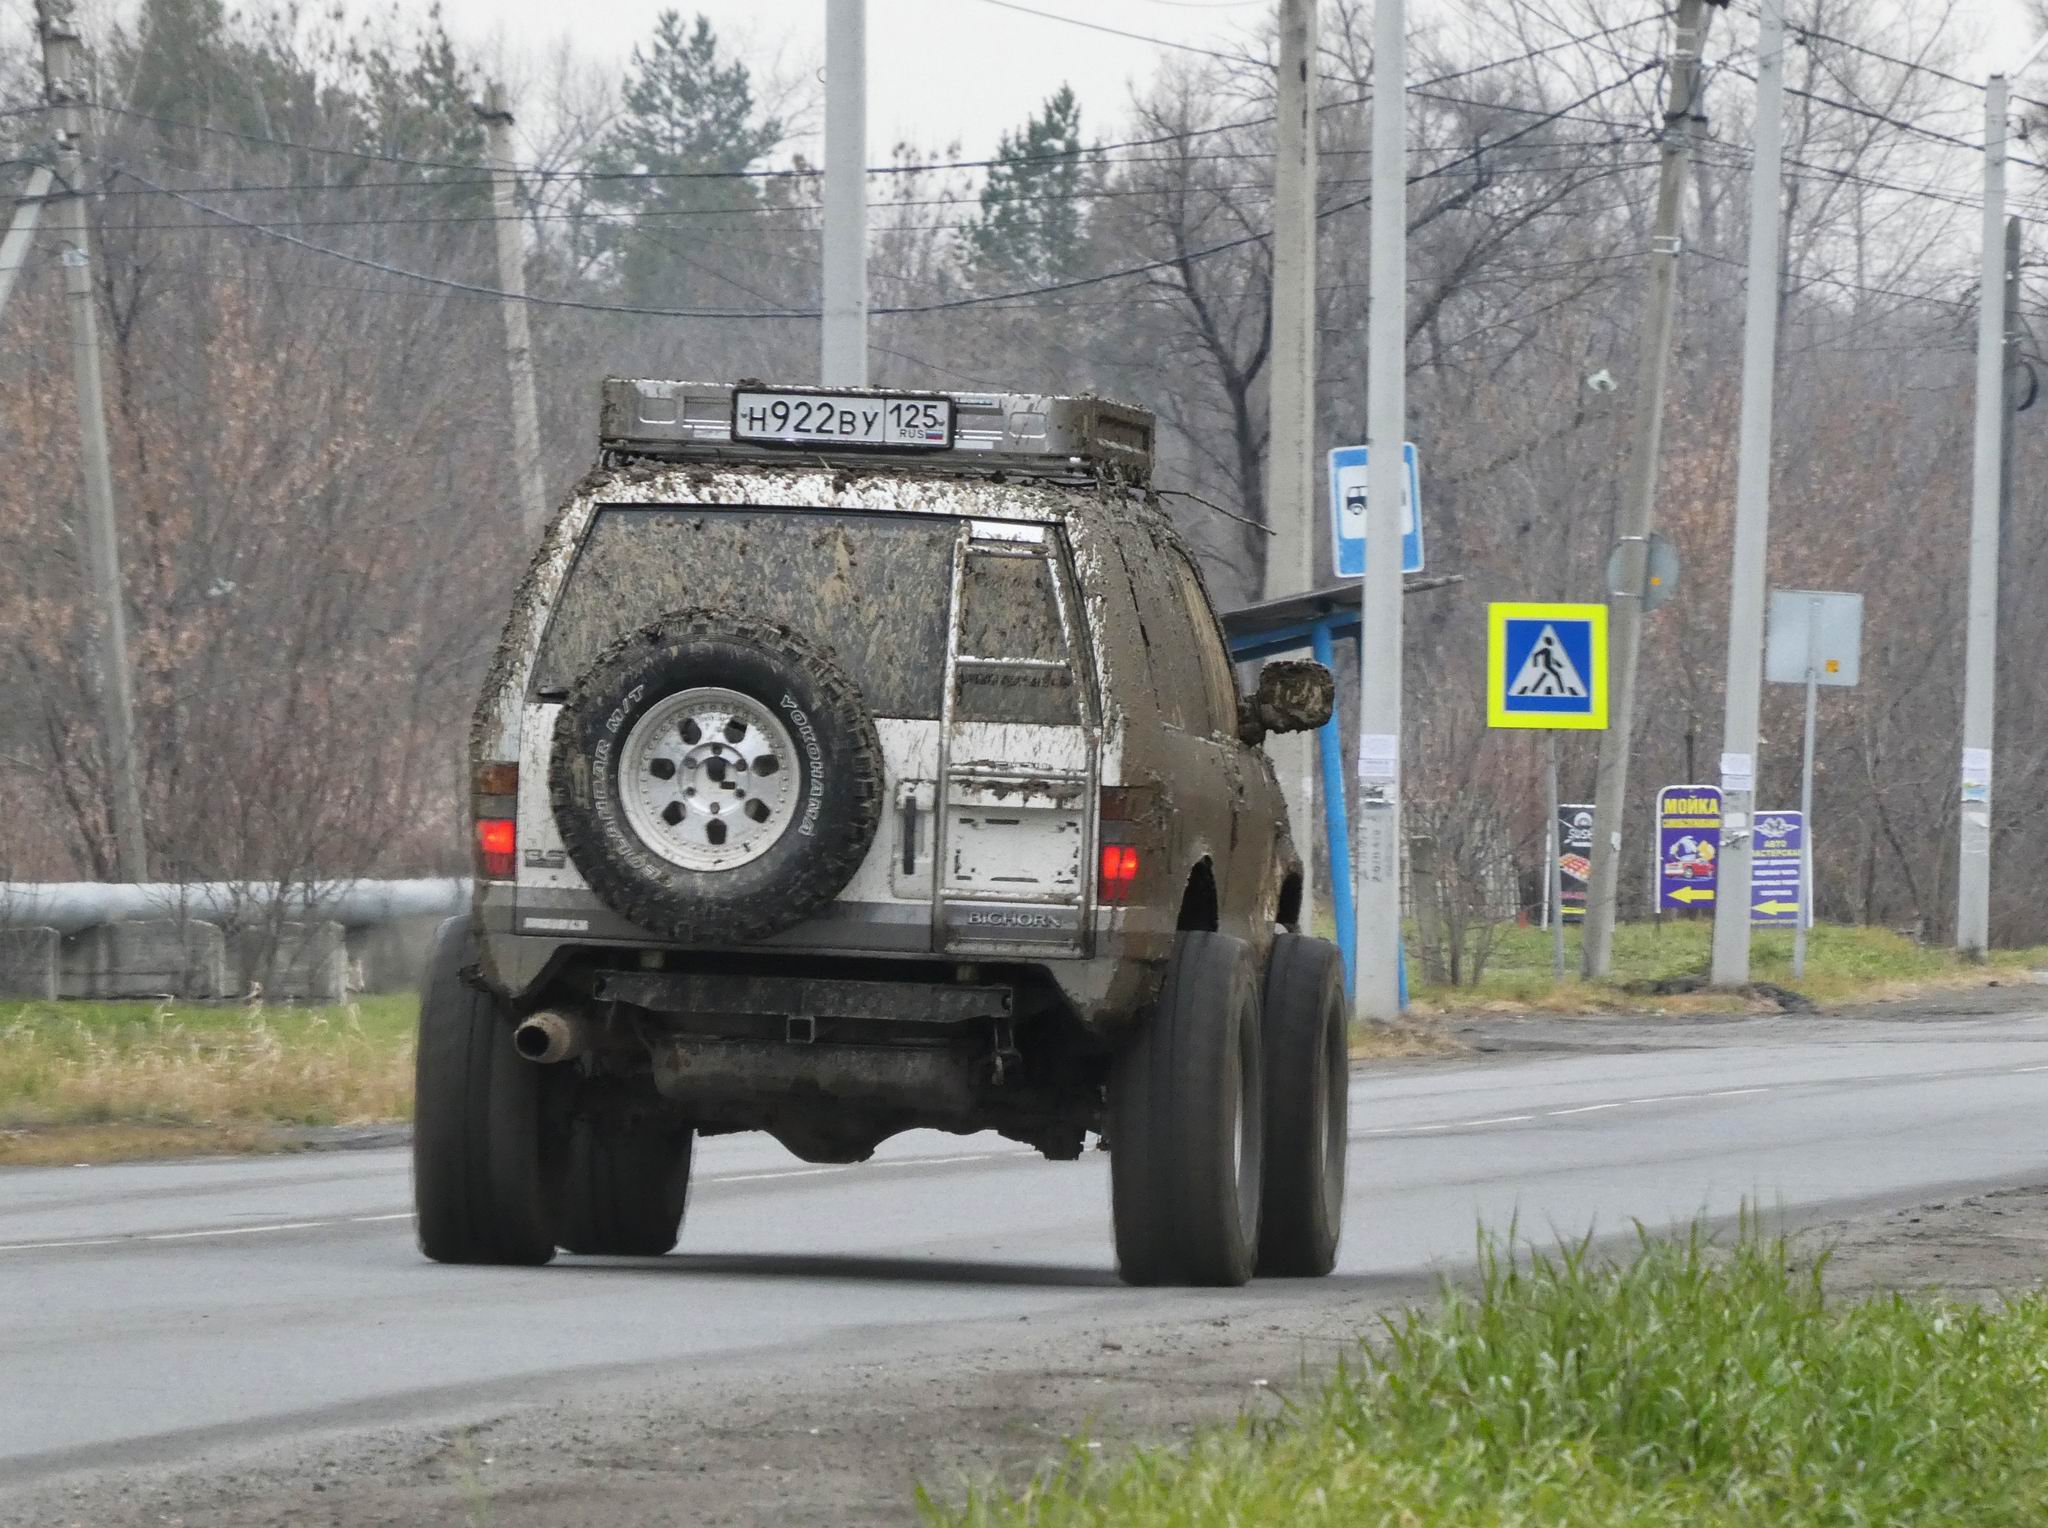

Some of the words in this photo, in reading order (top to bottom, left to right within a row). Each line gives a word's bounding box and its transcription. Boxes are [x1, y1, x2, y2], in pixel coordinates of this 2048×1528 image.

[889, 404, 939, 429] 125
[900, 429, 925, 439] RUS
[606, 684, 645, 733] M/T
[780, 694, 825, 837] YOKOHAMA
[1664, 795, 1720, 815] МОЙКА
[968, 911, 1062, 928] BIGHORN
